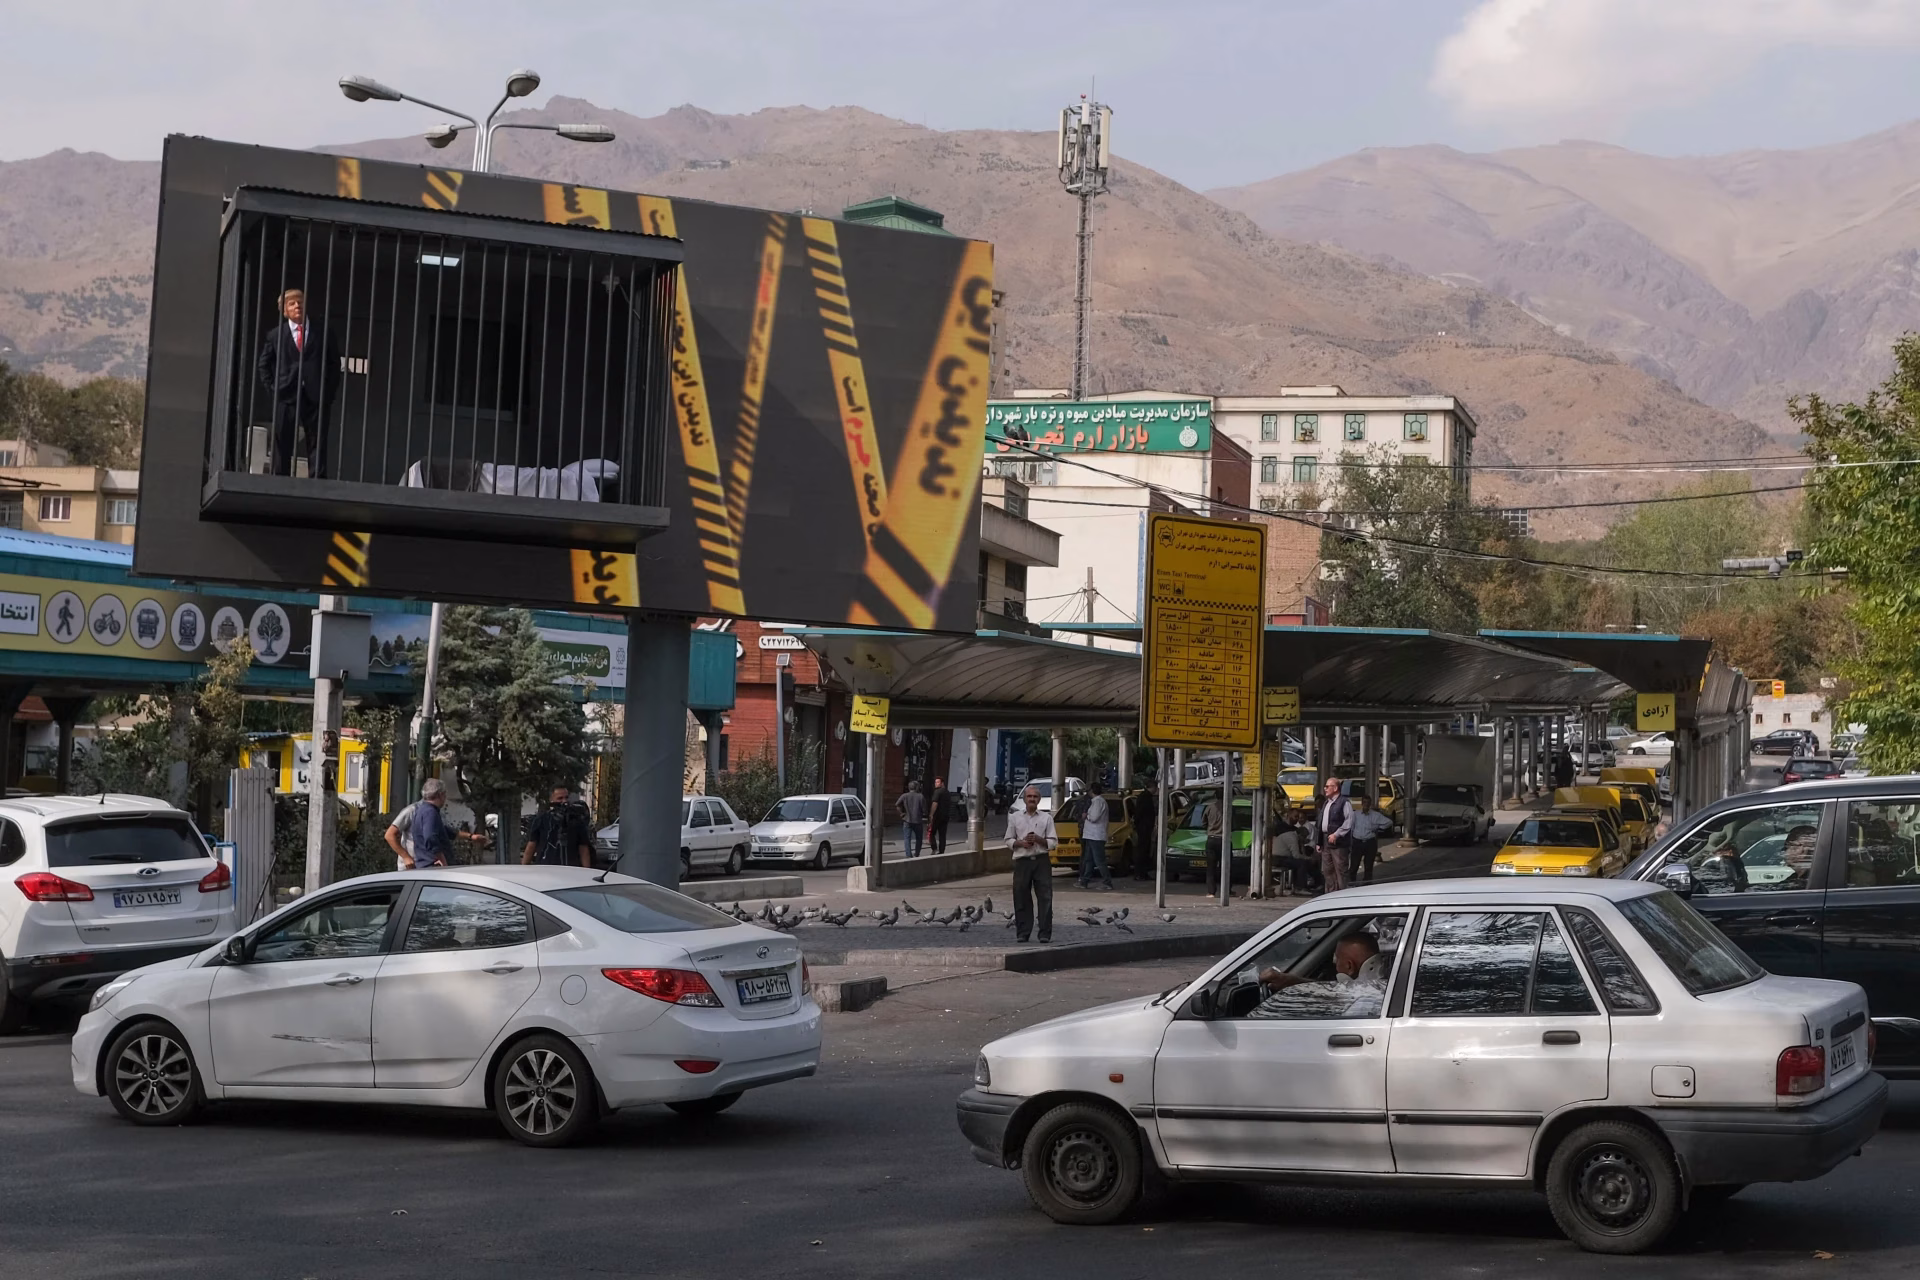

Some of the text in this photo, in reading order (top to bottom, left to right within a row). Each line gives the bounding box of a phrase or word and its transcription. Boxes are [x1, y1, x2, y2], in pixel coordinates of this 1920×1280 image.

[842, 375, 865, 413] است
[985, 403, 1209, 425] سازمان مدیریت میادین میوه و تره بار شهردار
[1073, 425, 1103, 451] ارم
[1108, 424, 1149, 450] بازار
[1172, 570, 1182, 578] Taxi
[1159, 583, 1171, 591] WC
[1, 603, 35, 622] انتخا
[1265, 701, 1297, 709] توحید
[1642, 704, 1670, 718] آزادی
